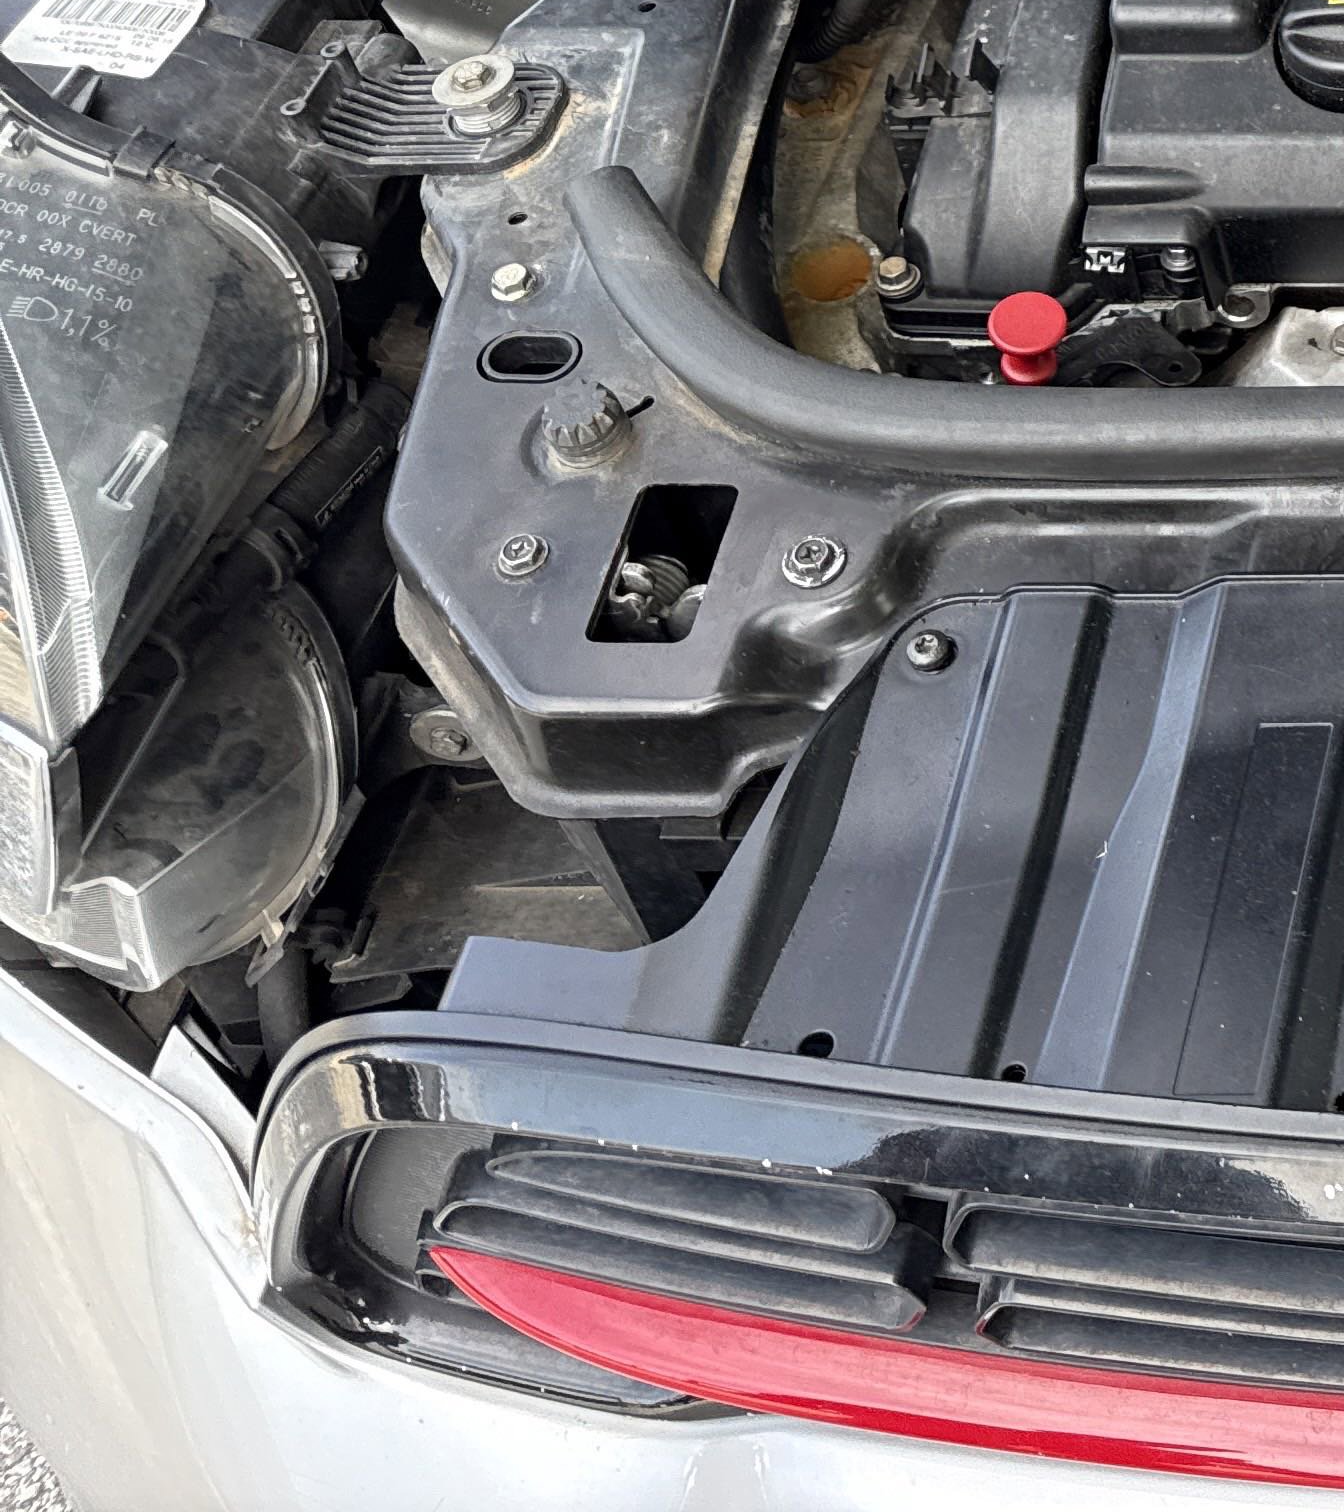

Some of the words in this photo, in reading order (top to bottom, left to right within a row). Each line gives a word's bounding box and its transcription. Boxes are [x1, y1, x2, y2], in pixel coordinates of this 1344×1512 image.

[78, 219, 137, 247] CVERT
[136, 207, 161, 228] PL
[38, 238, 86, 261] 2879
[93, 253, 144, 282] 2880
[60, 308, 118, 348] 1,1%
